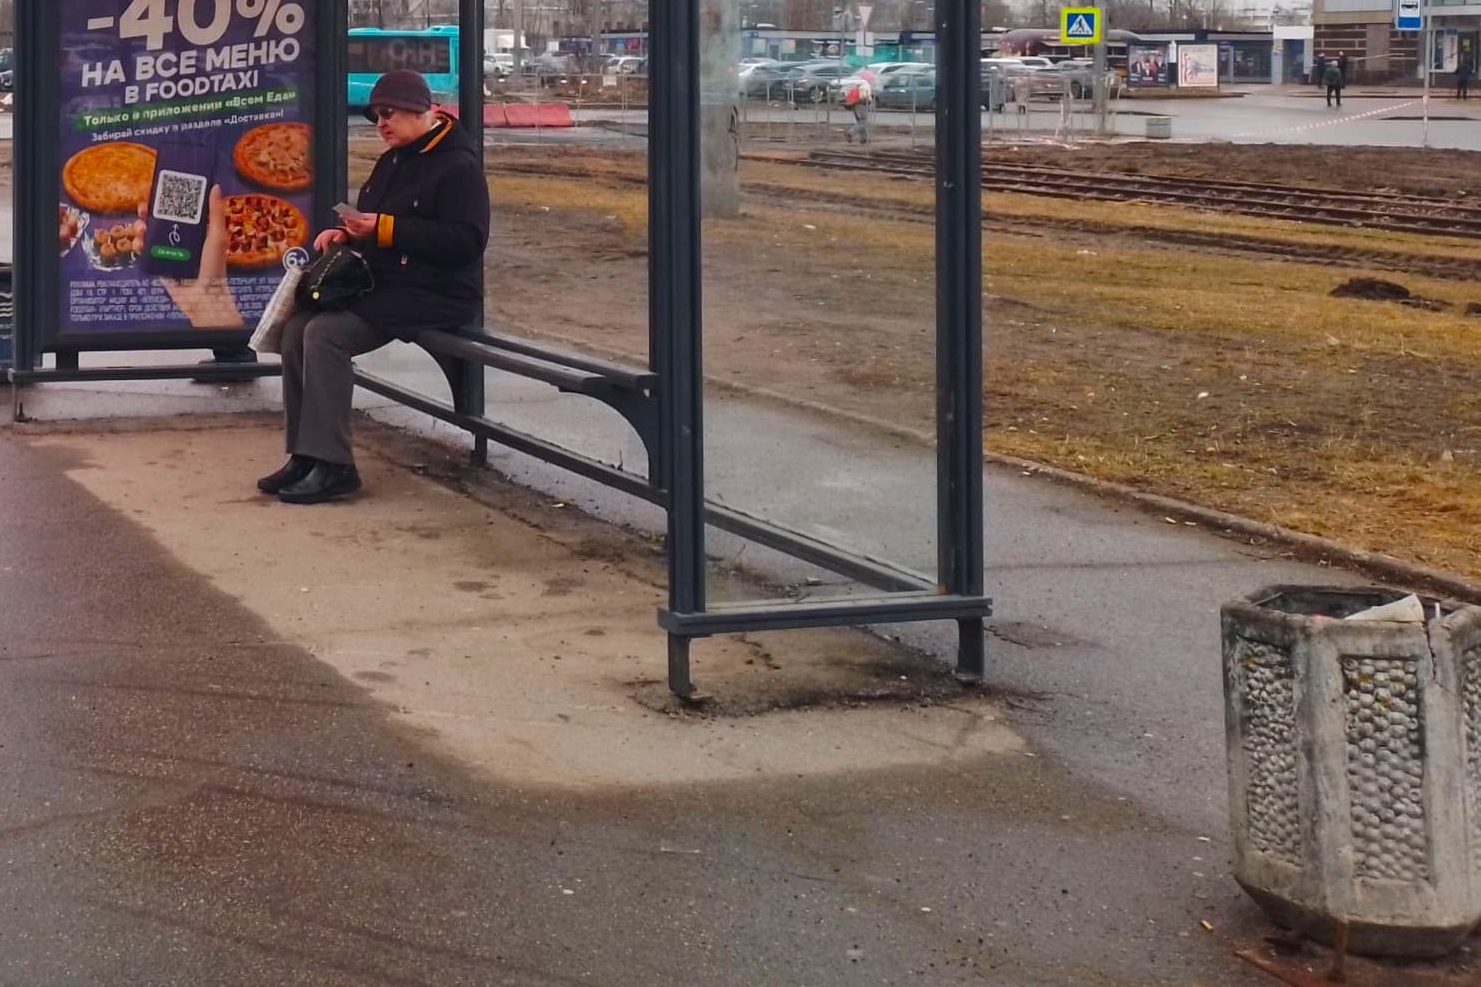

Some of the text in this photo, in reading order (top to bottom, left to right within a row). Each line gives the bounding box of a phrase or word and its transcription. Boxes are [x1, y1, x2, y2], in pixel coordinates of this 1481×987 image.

[81, 37, 301, 87] НА ВСЕ МЕНЮ
[125, 70, 258, 104] В FOODTAXI
[84, 112, 129, 126] Только
[132, 112, 140, 120] в
[143, 101, 223, 120] приложении
[91, 128, 132, 142] Забирай
[134, 125, 170, 136] скидку
[181, 119, 222, 132] разделе
[286, 252, 306, 267] 6+
